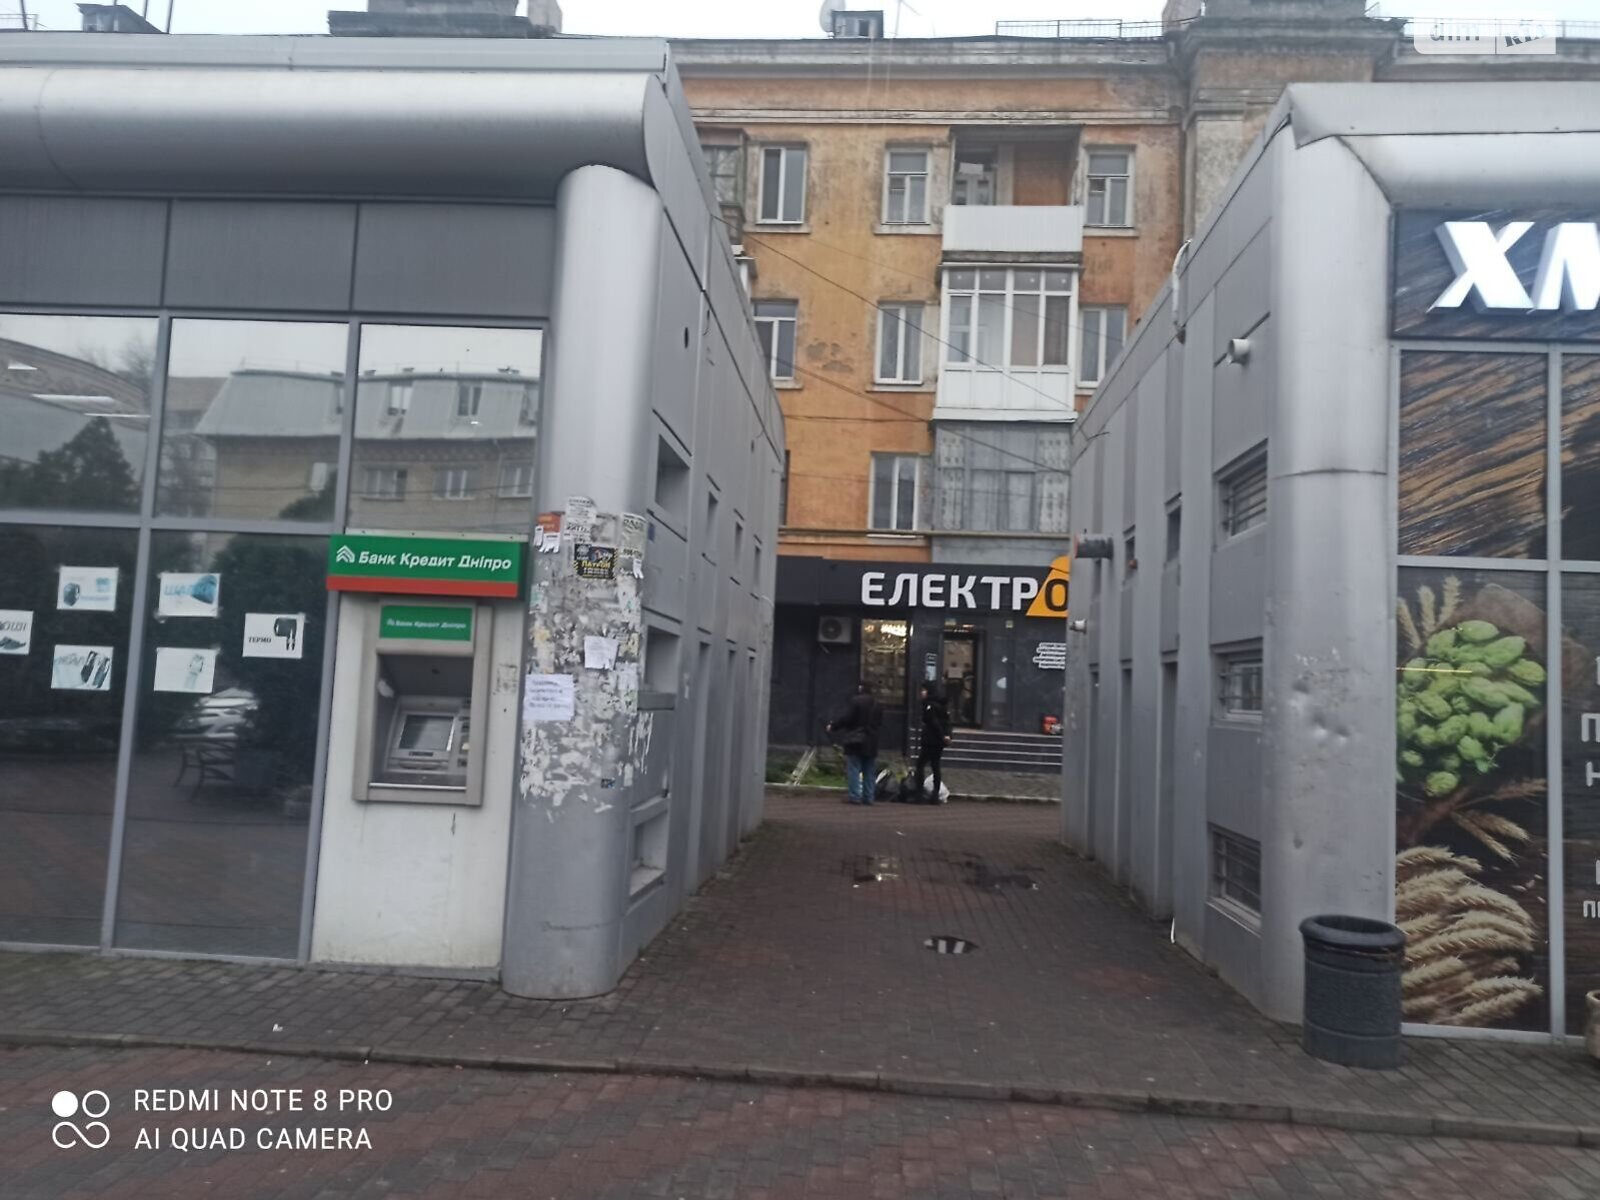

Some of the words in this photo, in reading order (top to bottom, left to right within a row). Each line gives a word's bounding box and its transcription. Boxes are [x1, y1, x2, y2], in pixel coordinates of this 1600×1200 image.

[358, 551, 396, 565] Банк
[399, 553, 455, 569] Кредит
[457, 555, 512, 572] Дніпро
[861, 571, 1069, 612] ЕЛЕКТРО
